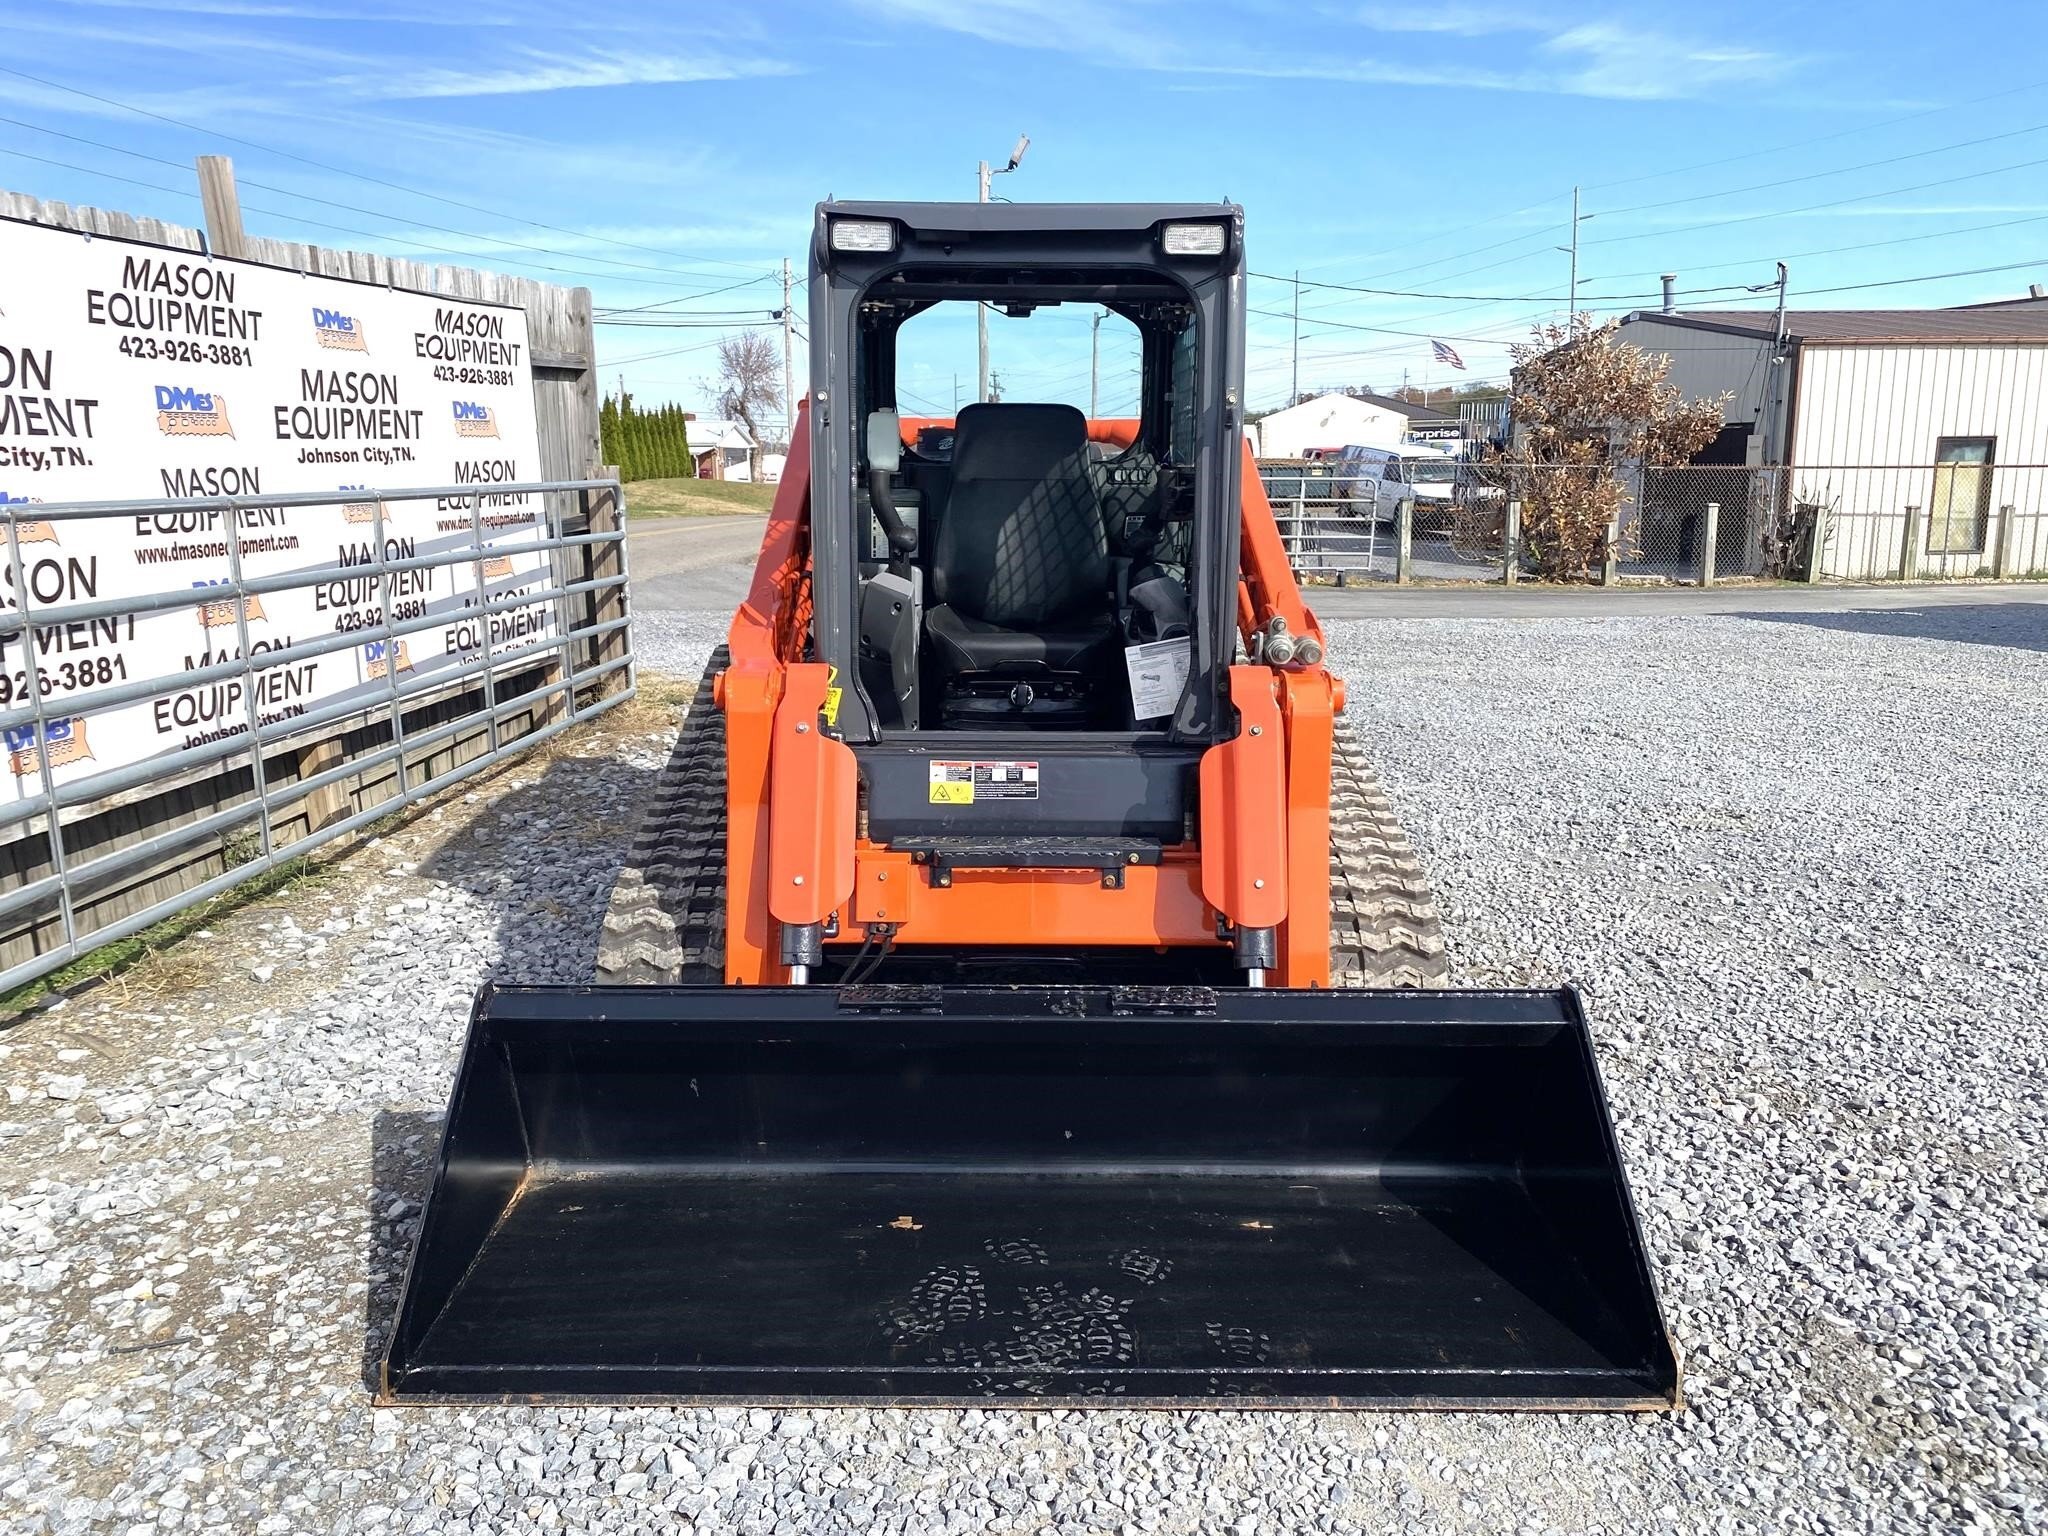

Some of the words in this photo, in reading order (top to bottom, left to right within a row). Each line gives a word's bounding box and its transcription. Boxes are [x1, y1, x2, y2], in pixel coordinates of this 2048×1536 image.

[122, 256, 235, 303] MASON
[87, 289, 262, 341] EQUIPMENT
[435, 308, 503, 339] MASON
[119, 335, 252, 367] 423-926-3881
[415, 332, 520, 367] EQUIPMENT
[301, 368, 398, 405] MASON
[433, 365, 514, 386] 423-926-3881
[274, 405, 423, 440] EQUIPMENT
[298, 449, 359, 464] Johnson
[455, 459, 515, 484] MASON
[160, 466, 260, 498] MASON
[335, 598, 427, 633] 423-92-3881
[445, 609, 546, 655] EQUPMENT
